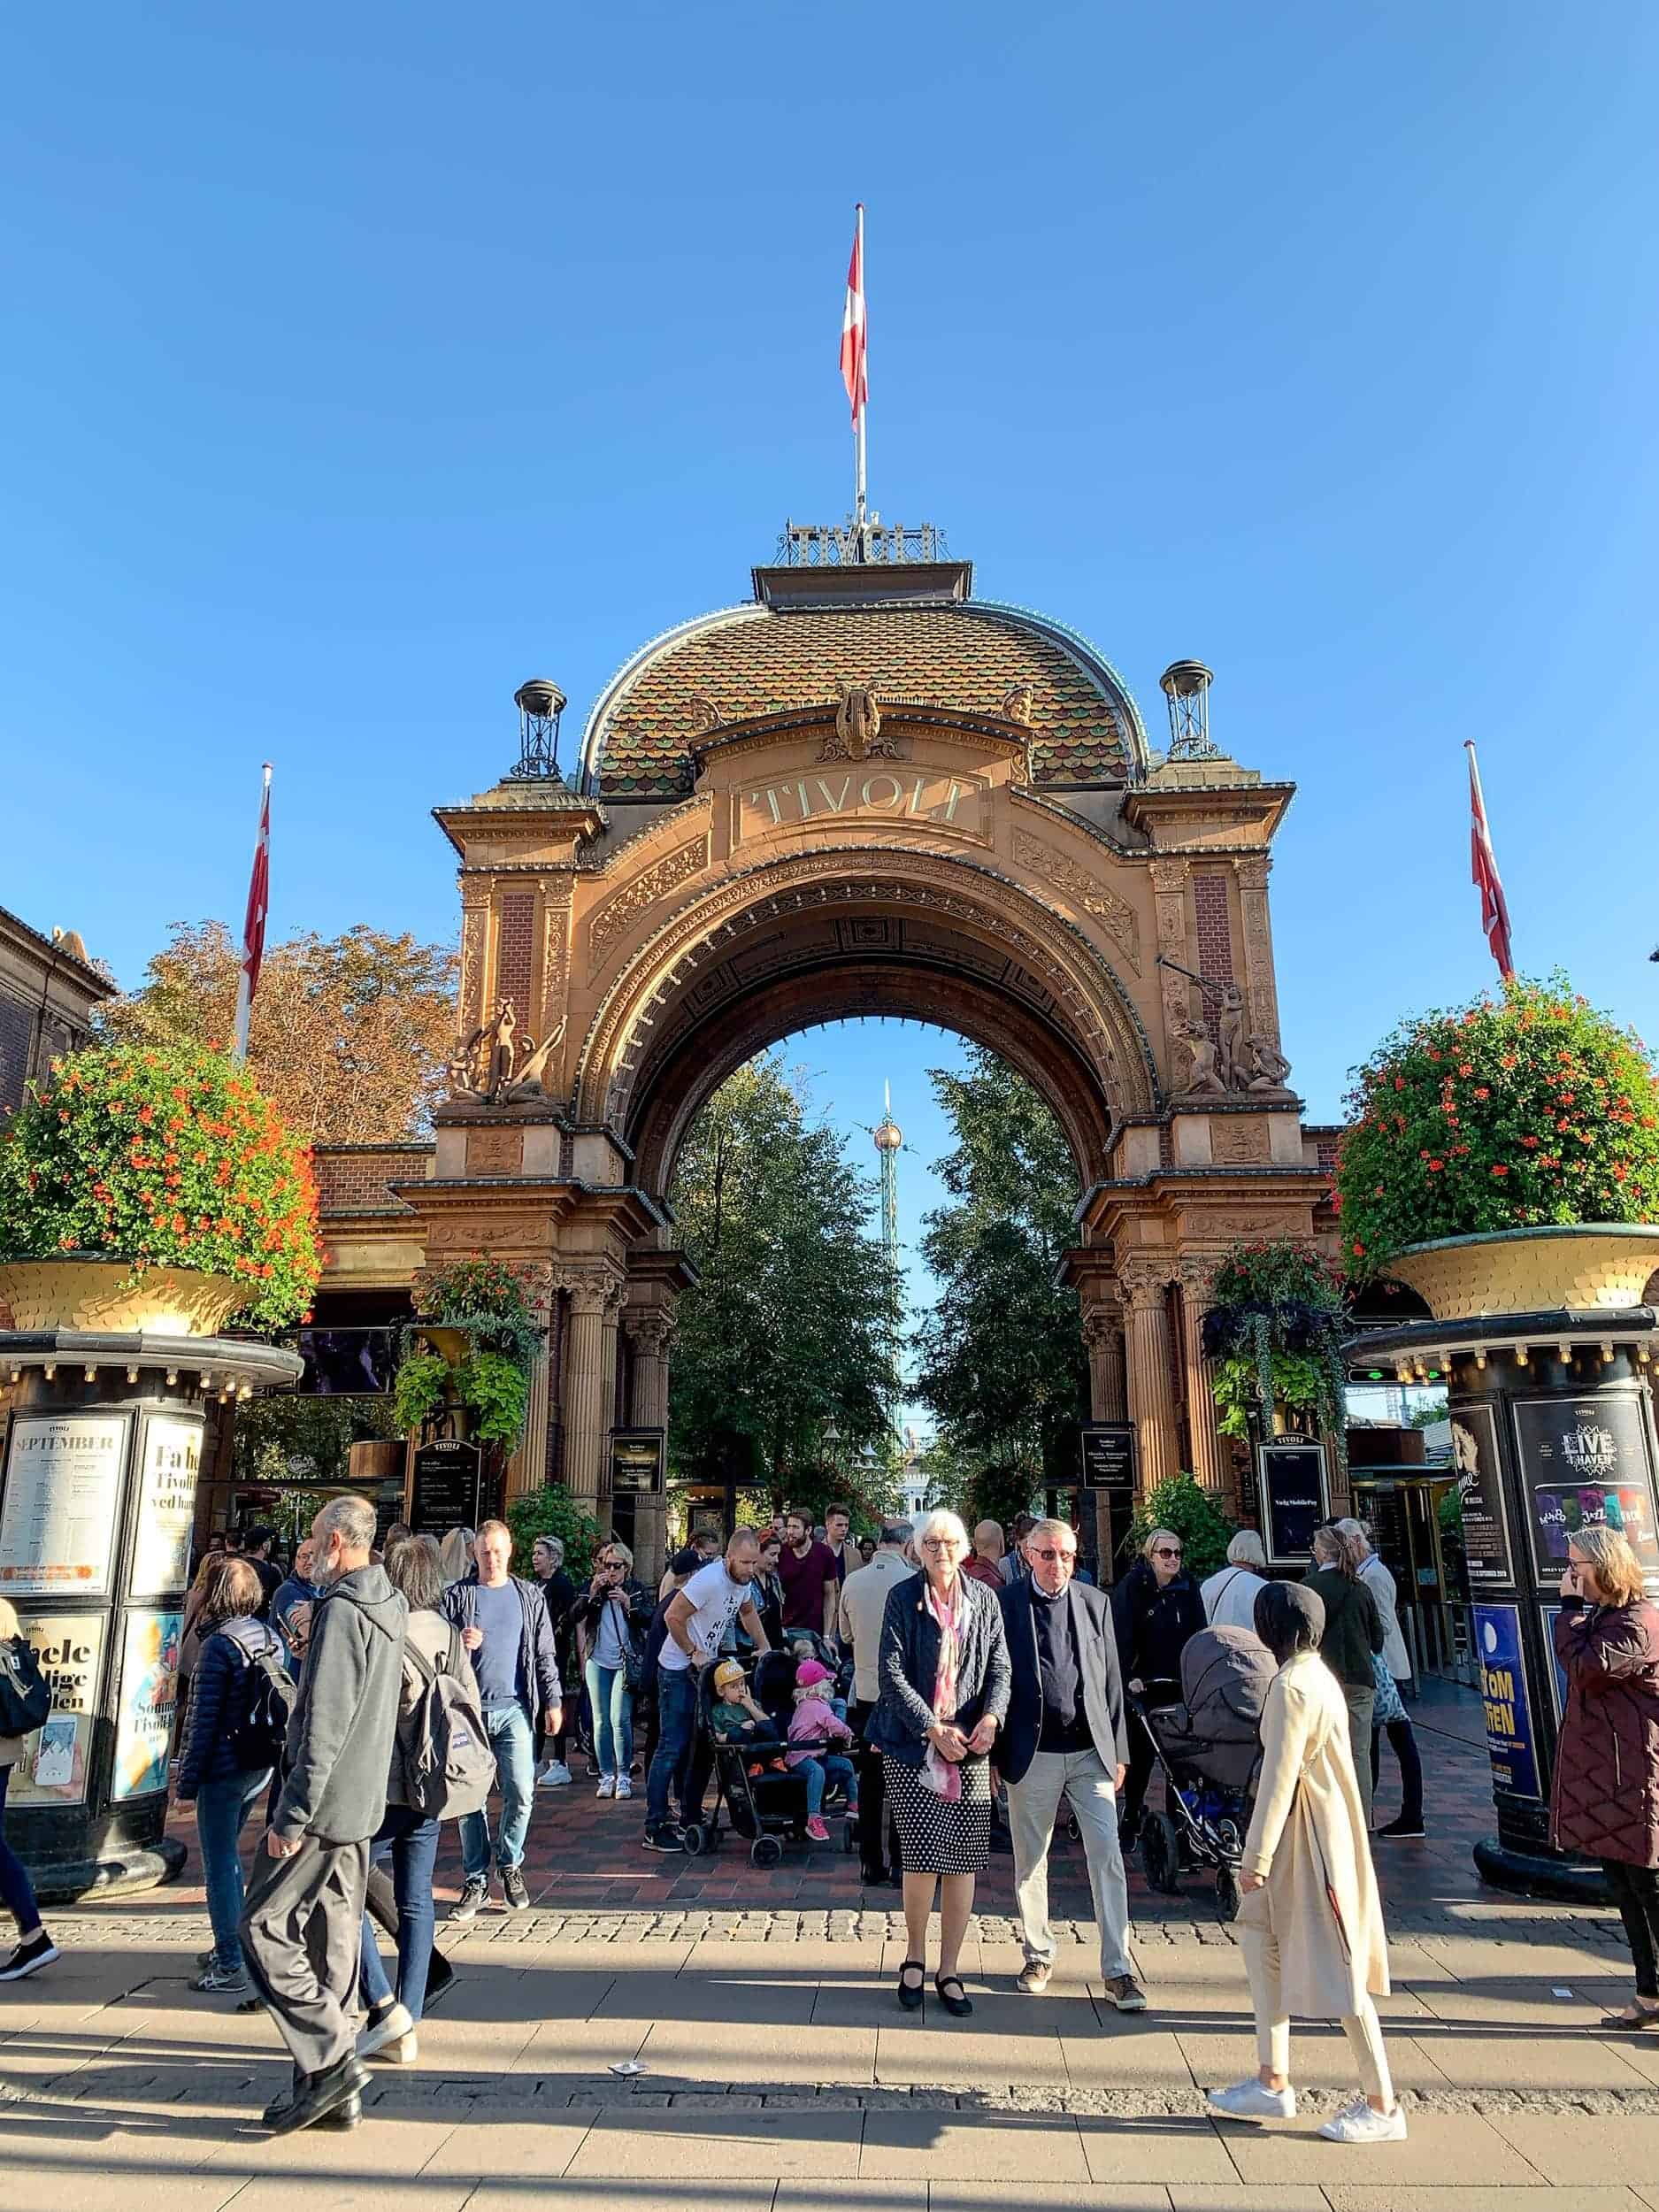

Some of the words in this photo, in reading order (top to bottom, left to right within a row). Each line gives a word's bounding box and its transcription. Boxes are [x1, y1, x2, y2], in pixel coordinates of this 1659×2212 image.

[791, 522, 932, 567] TIVOLI
[751, 775, 962, 825] TIVOLI
[14, 1436, 114, 1451] SEPTEMBER
[434, 1442, 460, 1451] TIVOLI
[1276, 1436, 1304, 1445] TIVOLI
[1562, 1432, 1615, 1454] LIVE
[150, 1494, 176, 1509] ved
